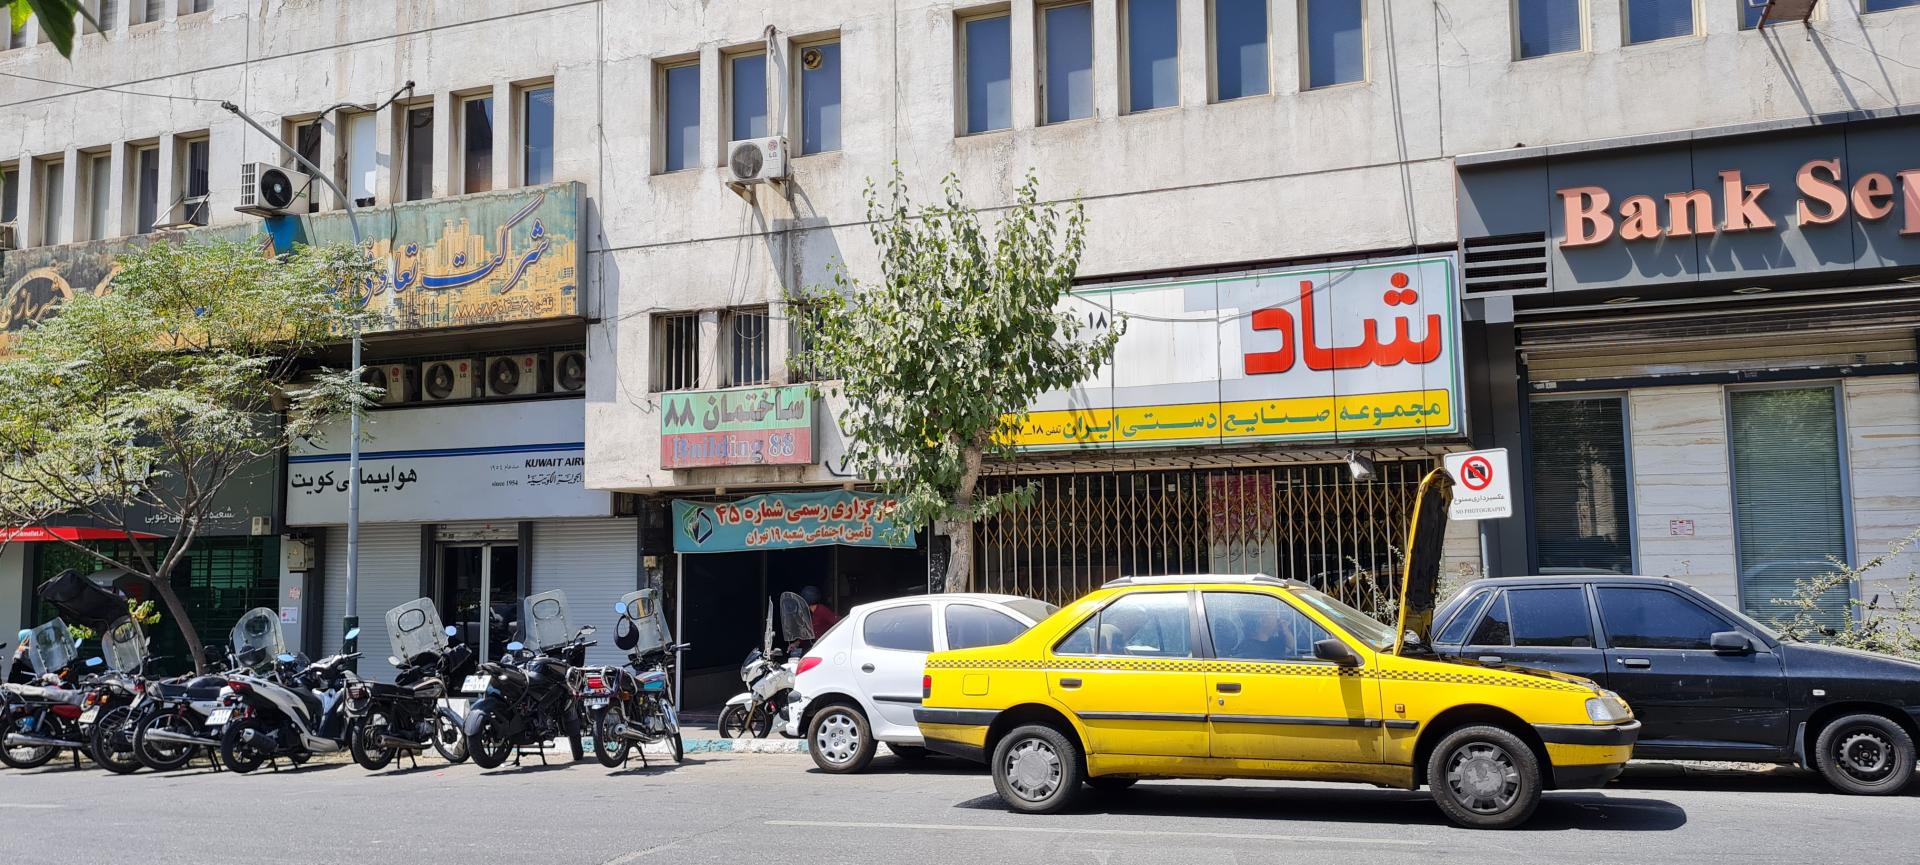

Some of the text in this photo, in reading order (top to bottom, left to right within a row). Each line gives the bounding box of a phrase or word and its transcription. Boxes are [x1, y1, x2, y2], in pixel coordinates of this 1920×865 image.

[1555, 169, 1777, 248] Bank
[421, 193, 550, 293] شرکت
[1244, 272, 1442, 375] شاد
[664, 389, 805, 431] ساختمان ۸۸
[1223, 404, 1331, 433] صنایع
[1339, 399, 1441, 426] مجموعه
[1045, 425, 1062, 437] تلفن
[1062, 414, 1120, 439] ایران
[1122, 412, 1218, 438] دستی
[671, 431, 796, 464] Building 88
[525, 458, 564, 468] KUWAIT
[291, 465, 418, 495] هواپیمای کویت
[506, 479, 519, 487] 1954
[144, 511, 168, 526] جنوبی
[714, 503, 741, 526] ۴۵
[743, 499, 784, 526] شماره
[786, 505, 830, 525] رسمی
[1464, 507, 1506, 515] PHOTOGRAPHY
[745, 527, 770, 546] تهران
[770, 526, 782, 543] ۱۹
[782, 526, 804, 542] شعبه
[804, 526, 844, 543] اجتماعی
